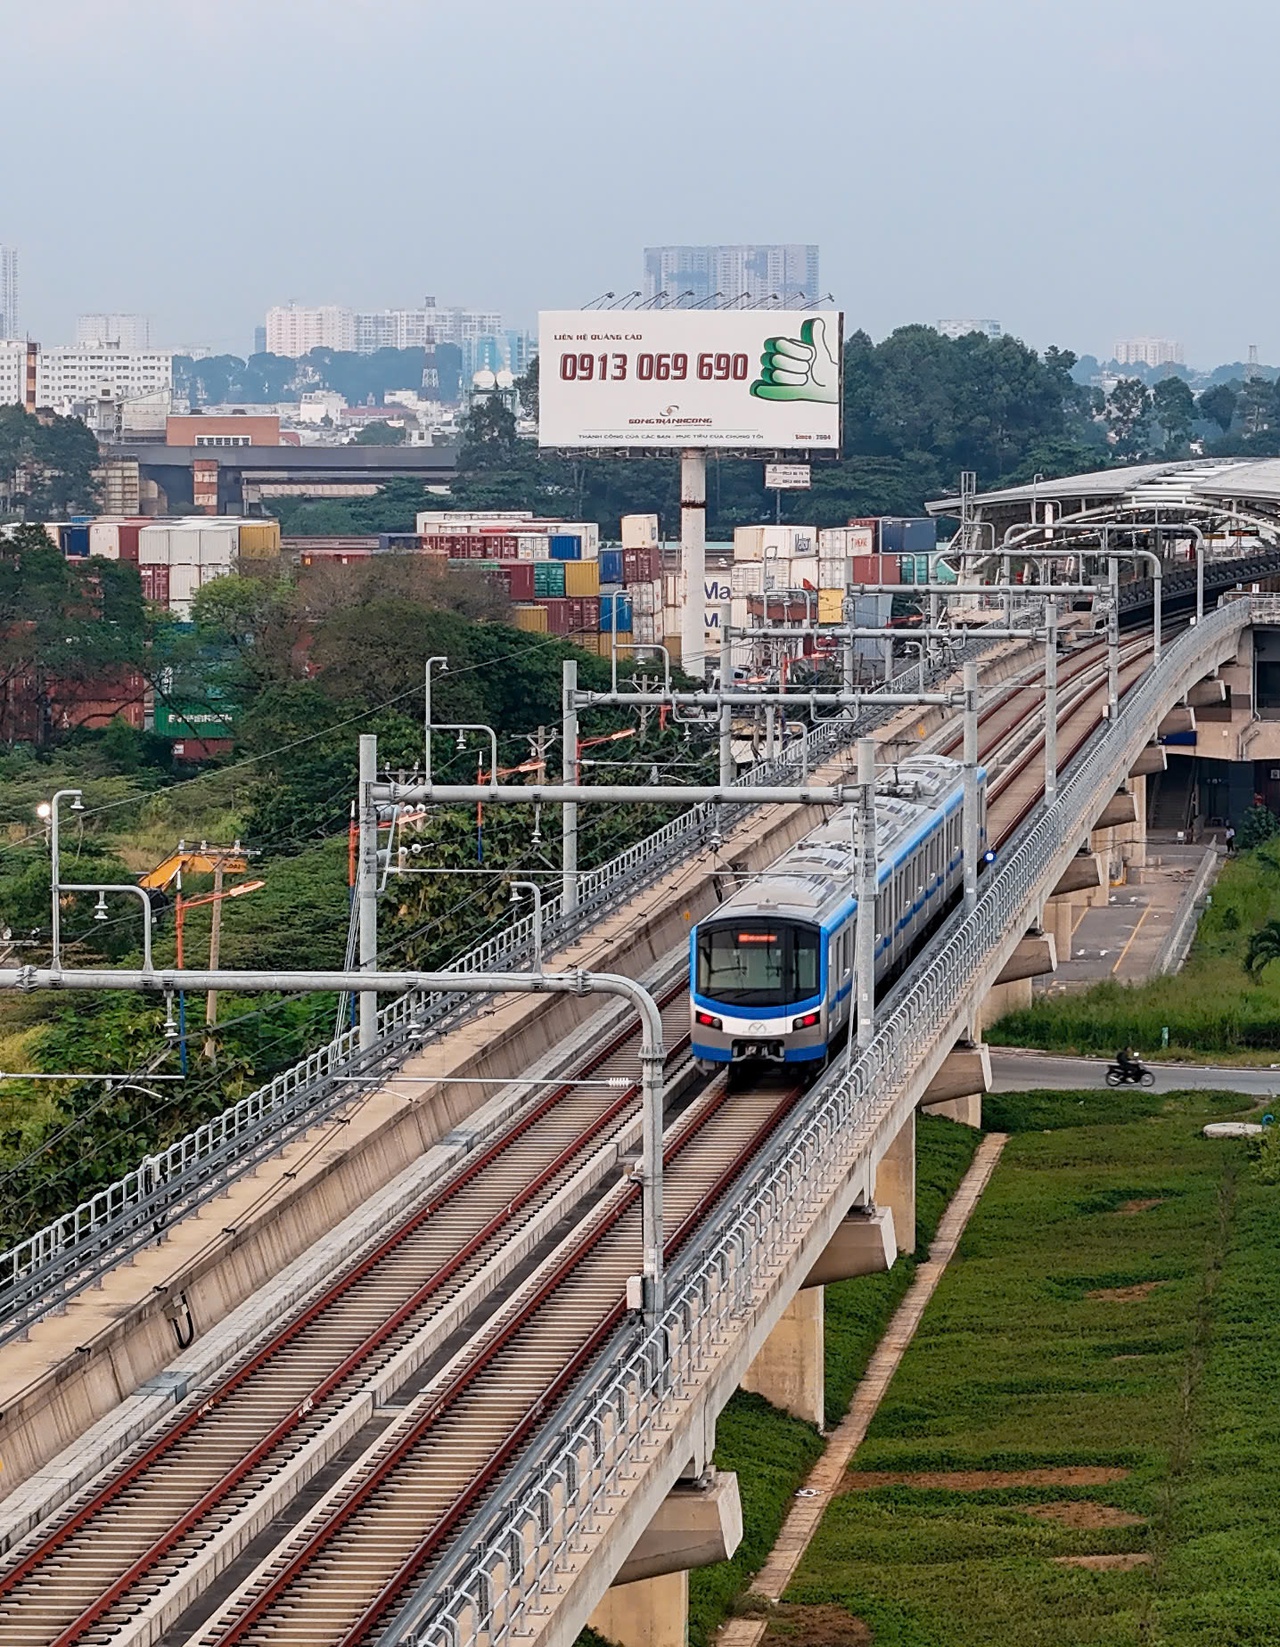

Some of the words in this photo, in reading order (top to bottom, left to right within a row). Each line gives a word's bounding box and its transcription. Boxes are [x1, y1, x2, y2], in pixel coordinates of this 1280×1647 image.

[560, 352, 628, 381] 0913
[636, 352, 688, 381] 069
[696, 352, 749, 381] 690
